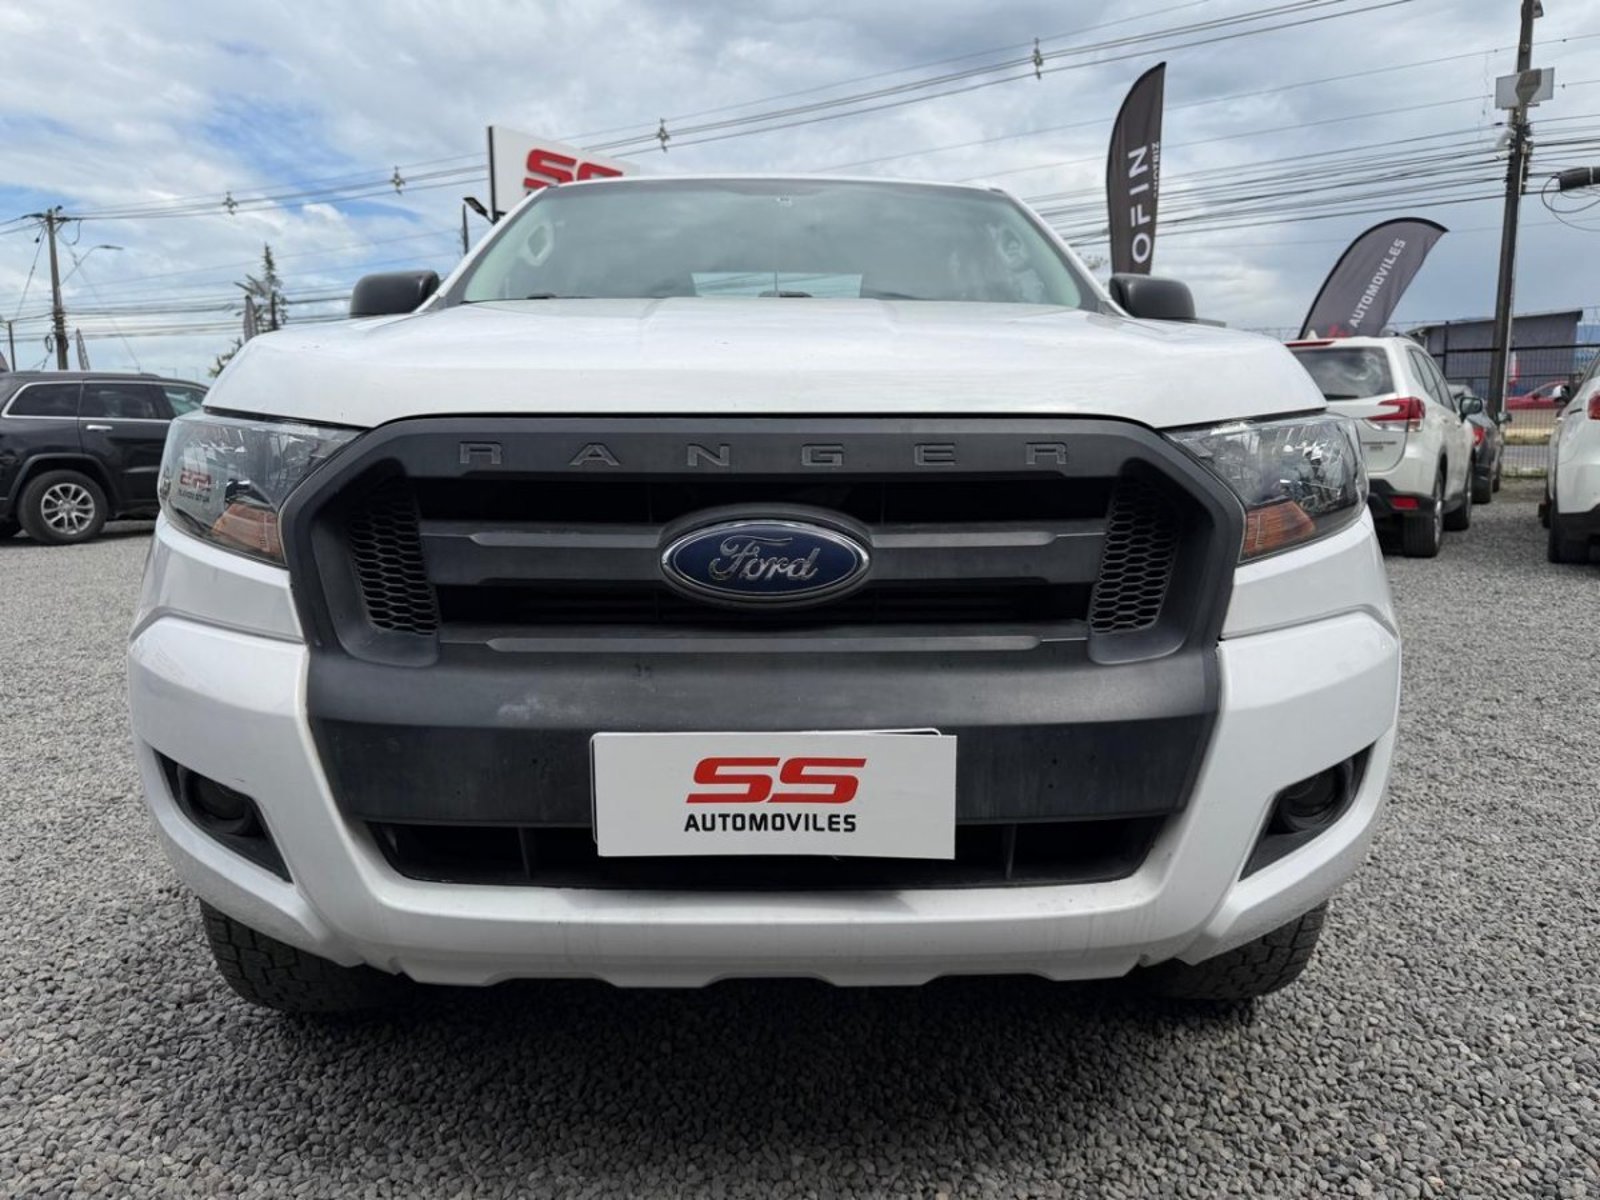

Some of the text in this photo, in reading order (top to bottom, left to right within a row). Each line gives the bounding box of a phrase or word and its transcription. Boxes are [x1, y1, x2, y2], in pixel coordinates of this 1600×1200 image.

[1128, 146, 1151, 264] OFIN
[1348, 238, 1406, 328] AUTOMOVILES
[459, 441, 1067, 466] RANGER
[708, 534, 820, 581] Ford
[686, 757, 867, 804] SS
[684, 813, 857, 833] AUTOMOVILES
